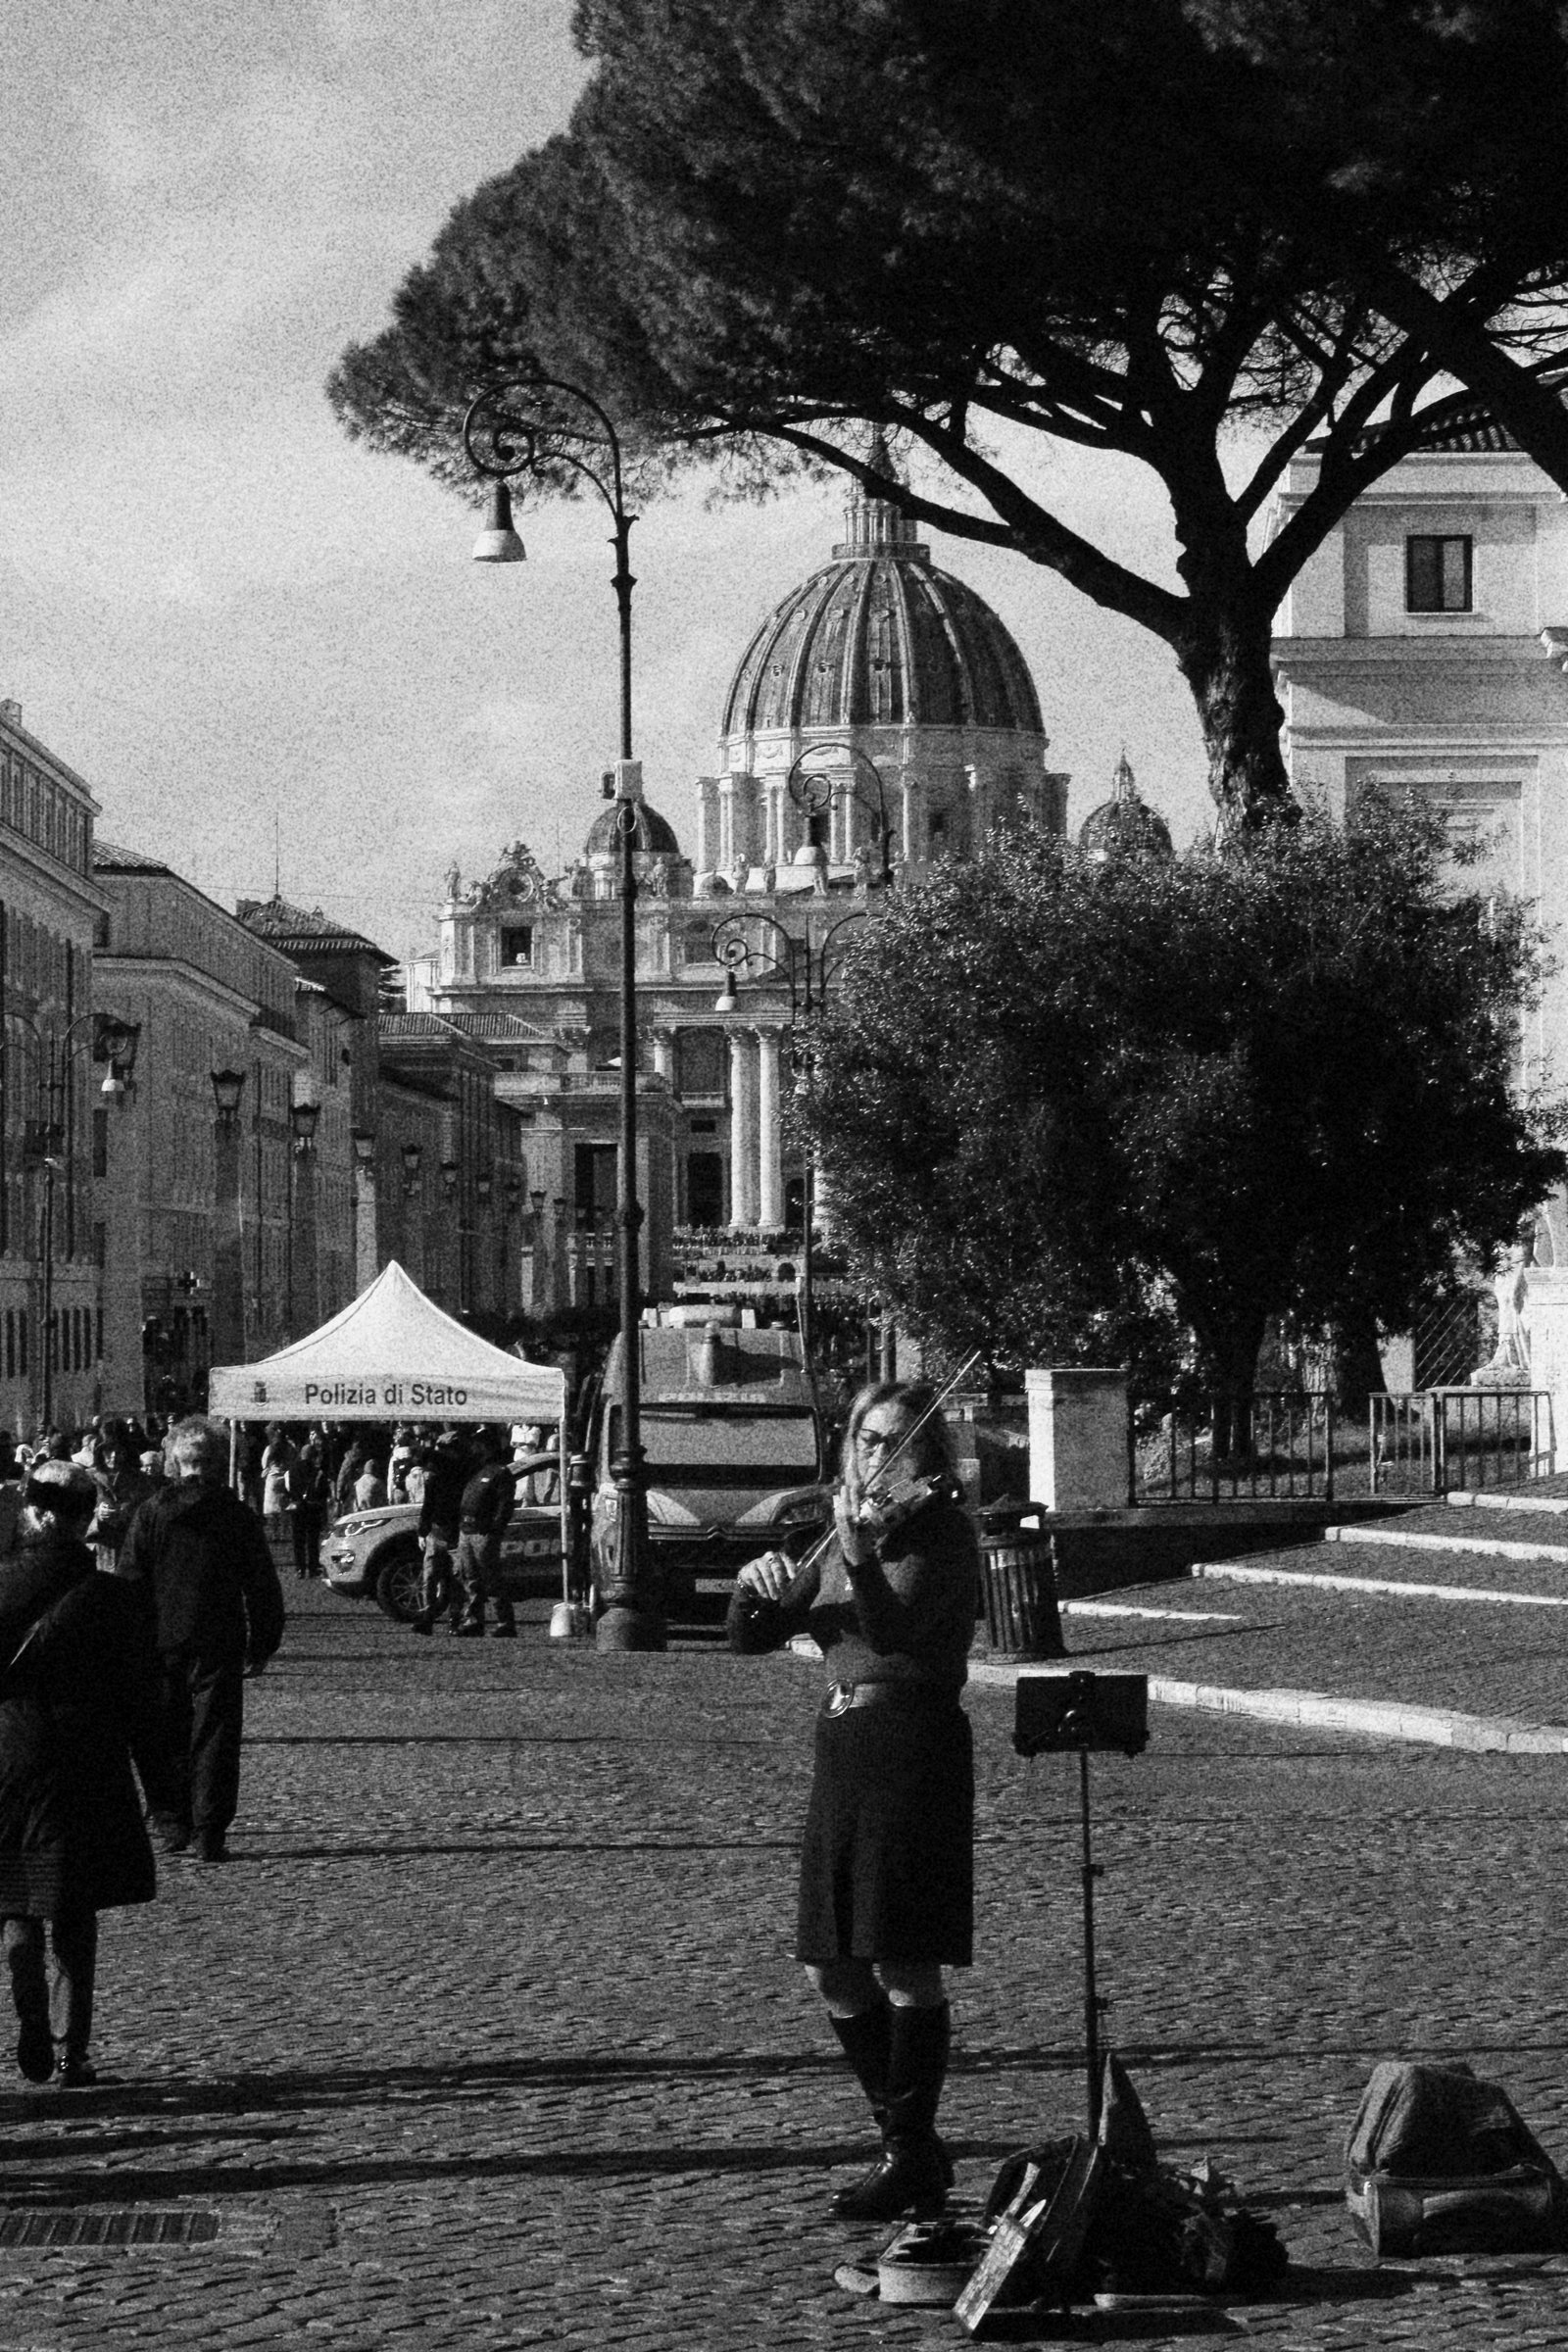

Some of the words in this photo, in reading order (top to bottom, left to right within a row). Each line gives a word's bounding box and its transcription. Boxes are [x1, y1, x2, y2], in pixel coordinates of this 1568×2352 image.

[305, 1383, 376, 1405] Polizia
[384, 1383, 403, 1404] di
[411, 1383, 467, 1405] Stato
